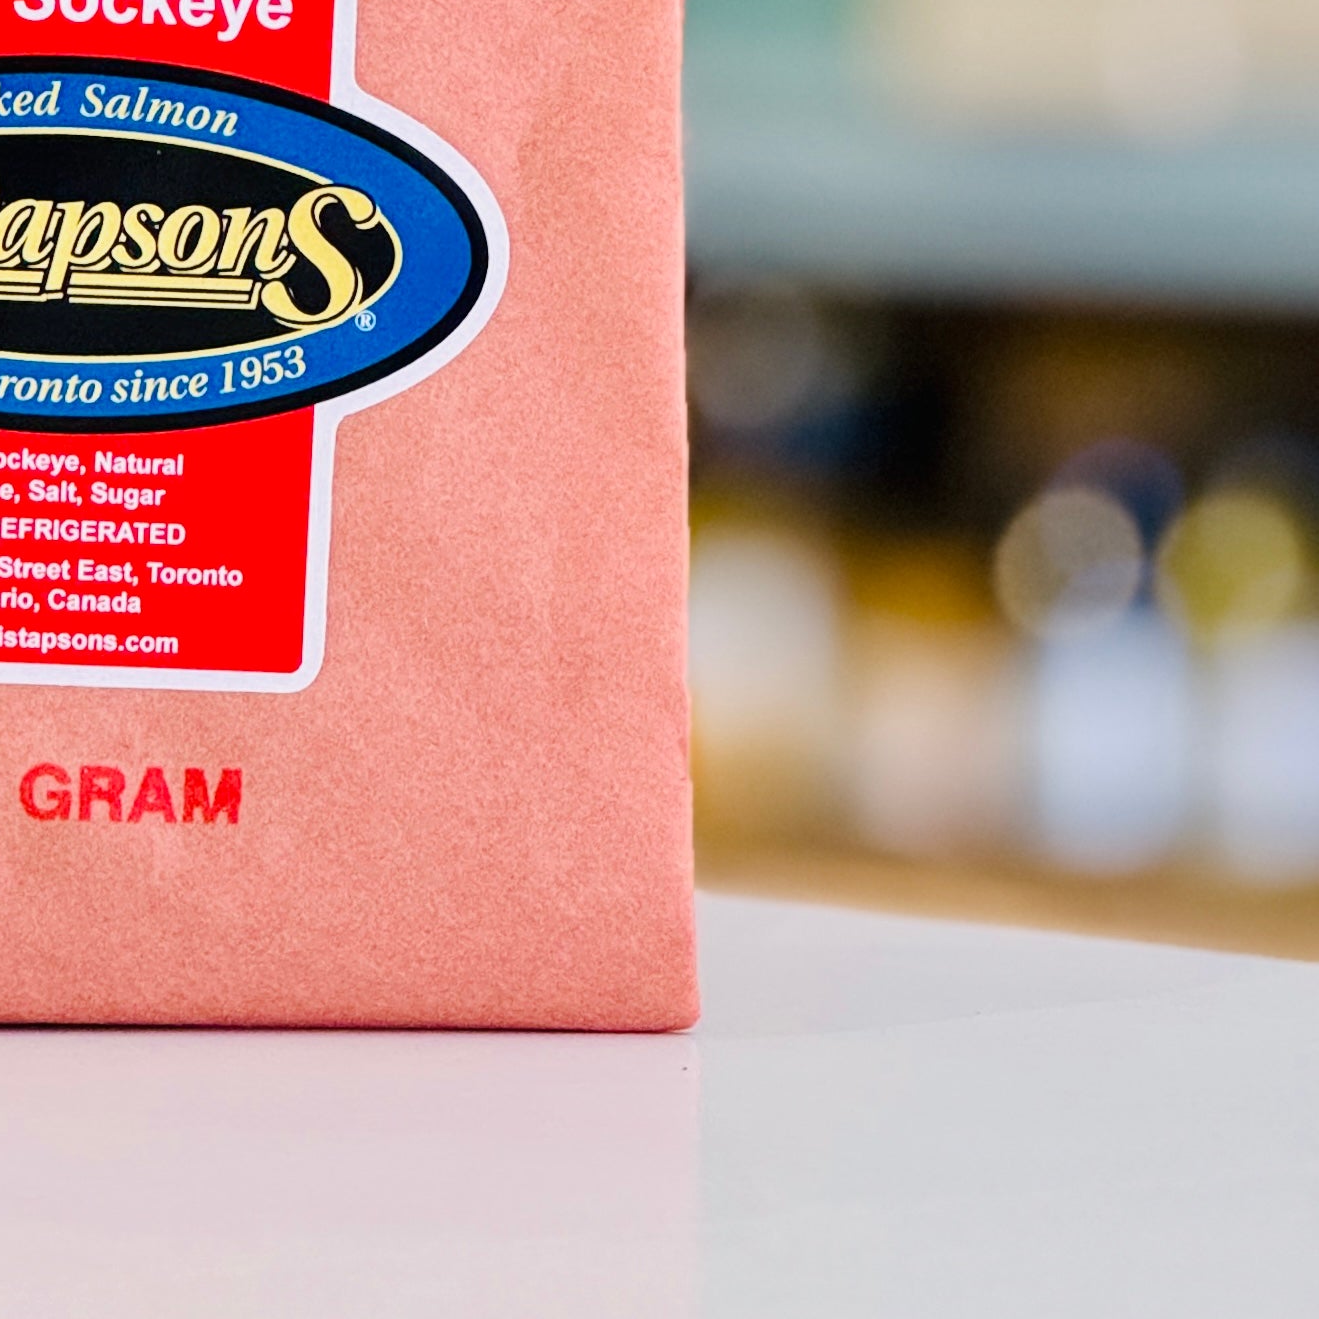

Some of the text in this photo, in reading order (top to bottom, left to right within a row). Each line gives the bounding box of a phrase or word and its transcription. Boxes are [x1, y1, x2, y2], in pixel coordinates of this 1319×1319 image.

[80, 83, 240, 136] Salmon
[110, 369, 208, 403] since
[222, 349, 307, 392] 1953
[95, 451, 184, 476] Natural
[28, 480, 83, 506] Salt,
[91, 482, 166, 511] Sugar
[78, 559, 139, 586] East,
[147, 562, 244, 587] Toronto
[48, 588, 142, 613] Canada
[19, 762, 243, 824] GRAM
